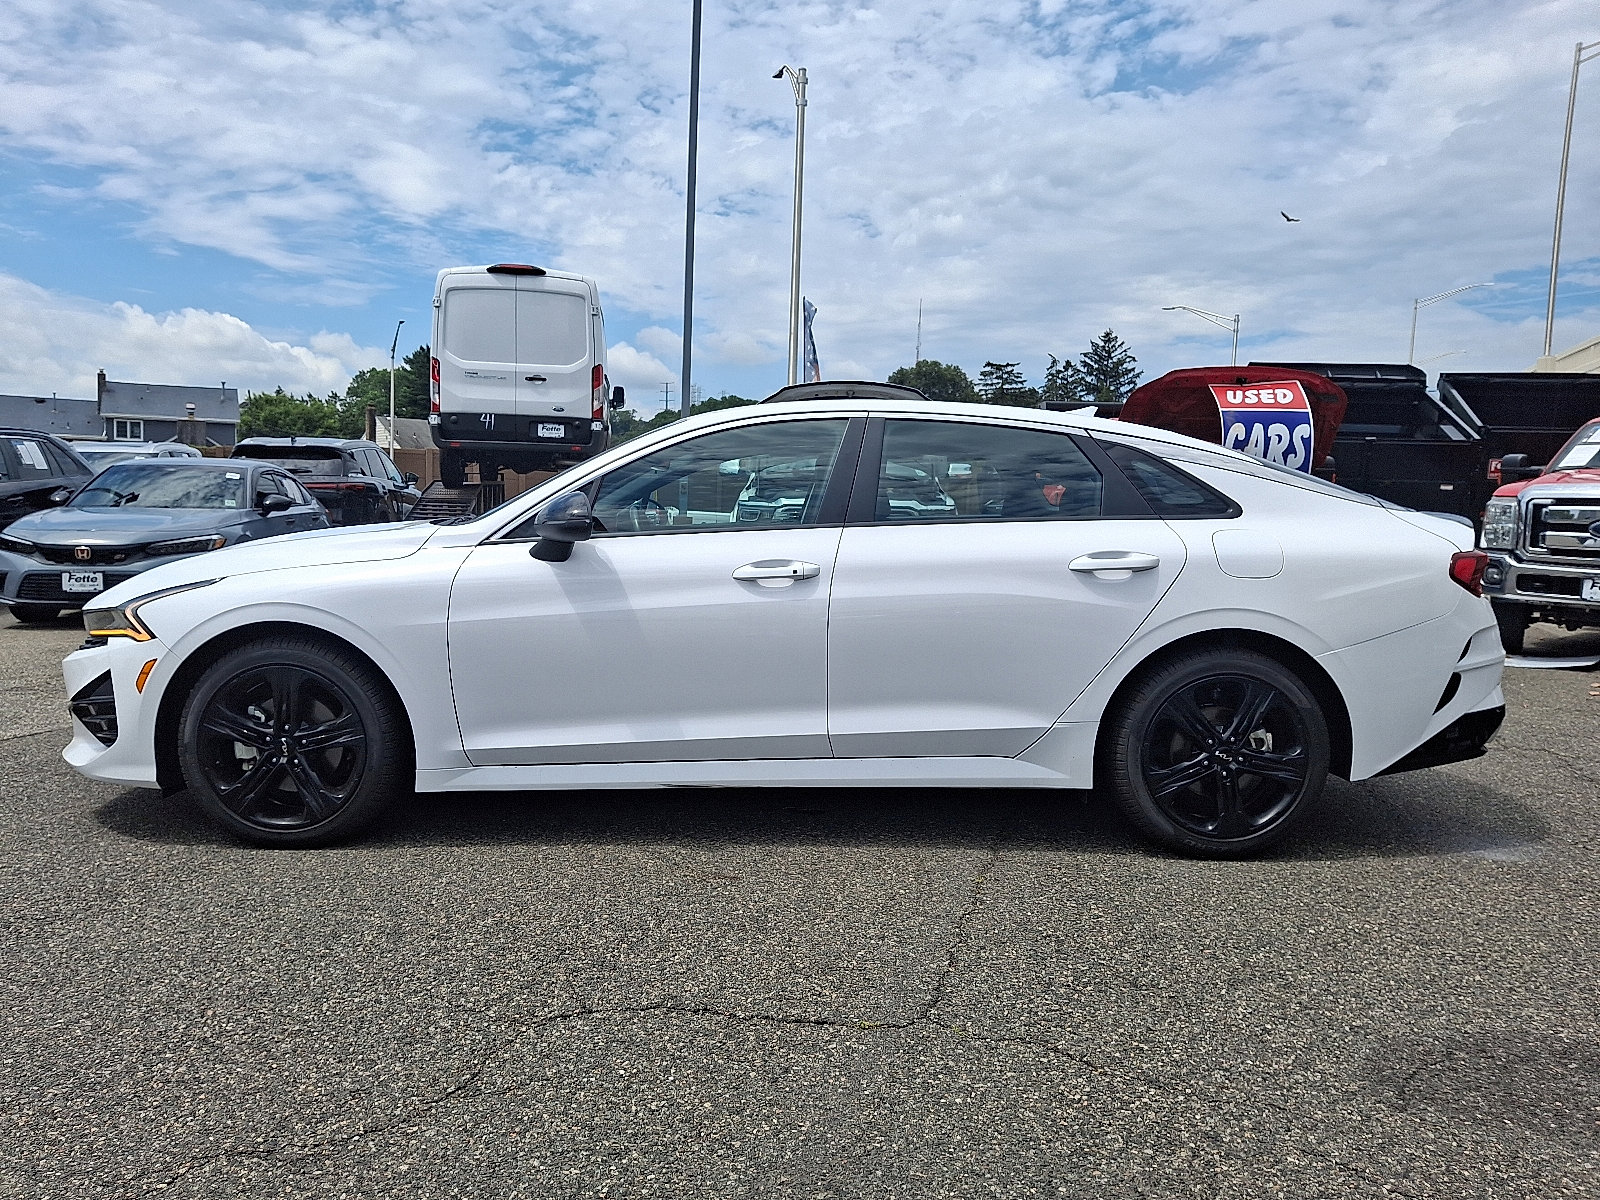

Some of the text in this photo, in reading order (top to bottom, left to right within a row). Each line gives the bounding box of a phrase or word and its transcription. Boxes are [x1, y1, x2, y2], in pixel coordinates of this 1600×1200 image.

[1226, 388, 1294, 404] USED
[480, 413, 495, 431] 41
[1224, 422, 1311, 469] CARS
[68, 573, 98, 583] Fette
